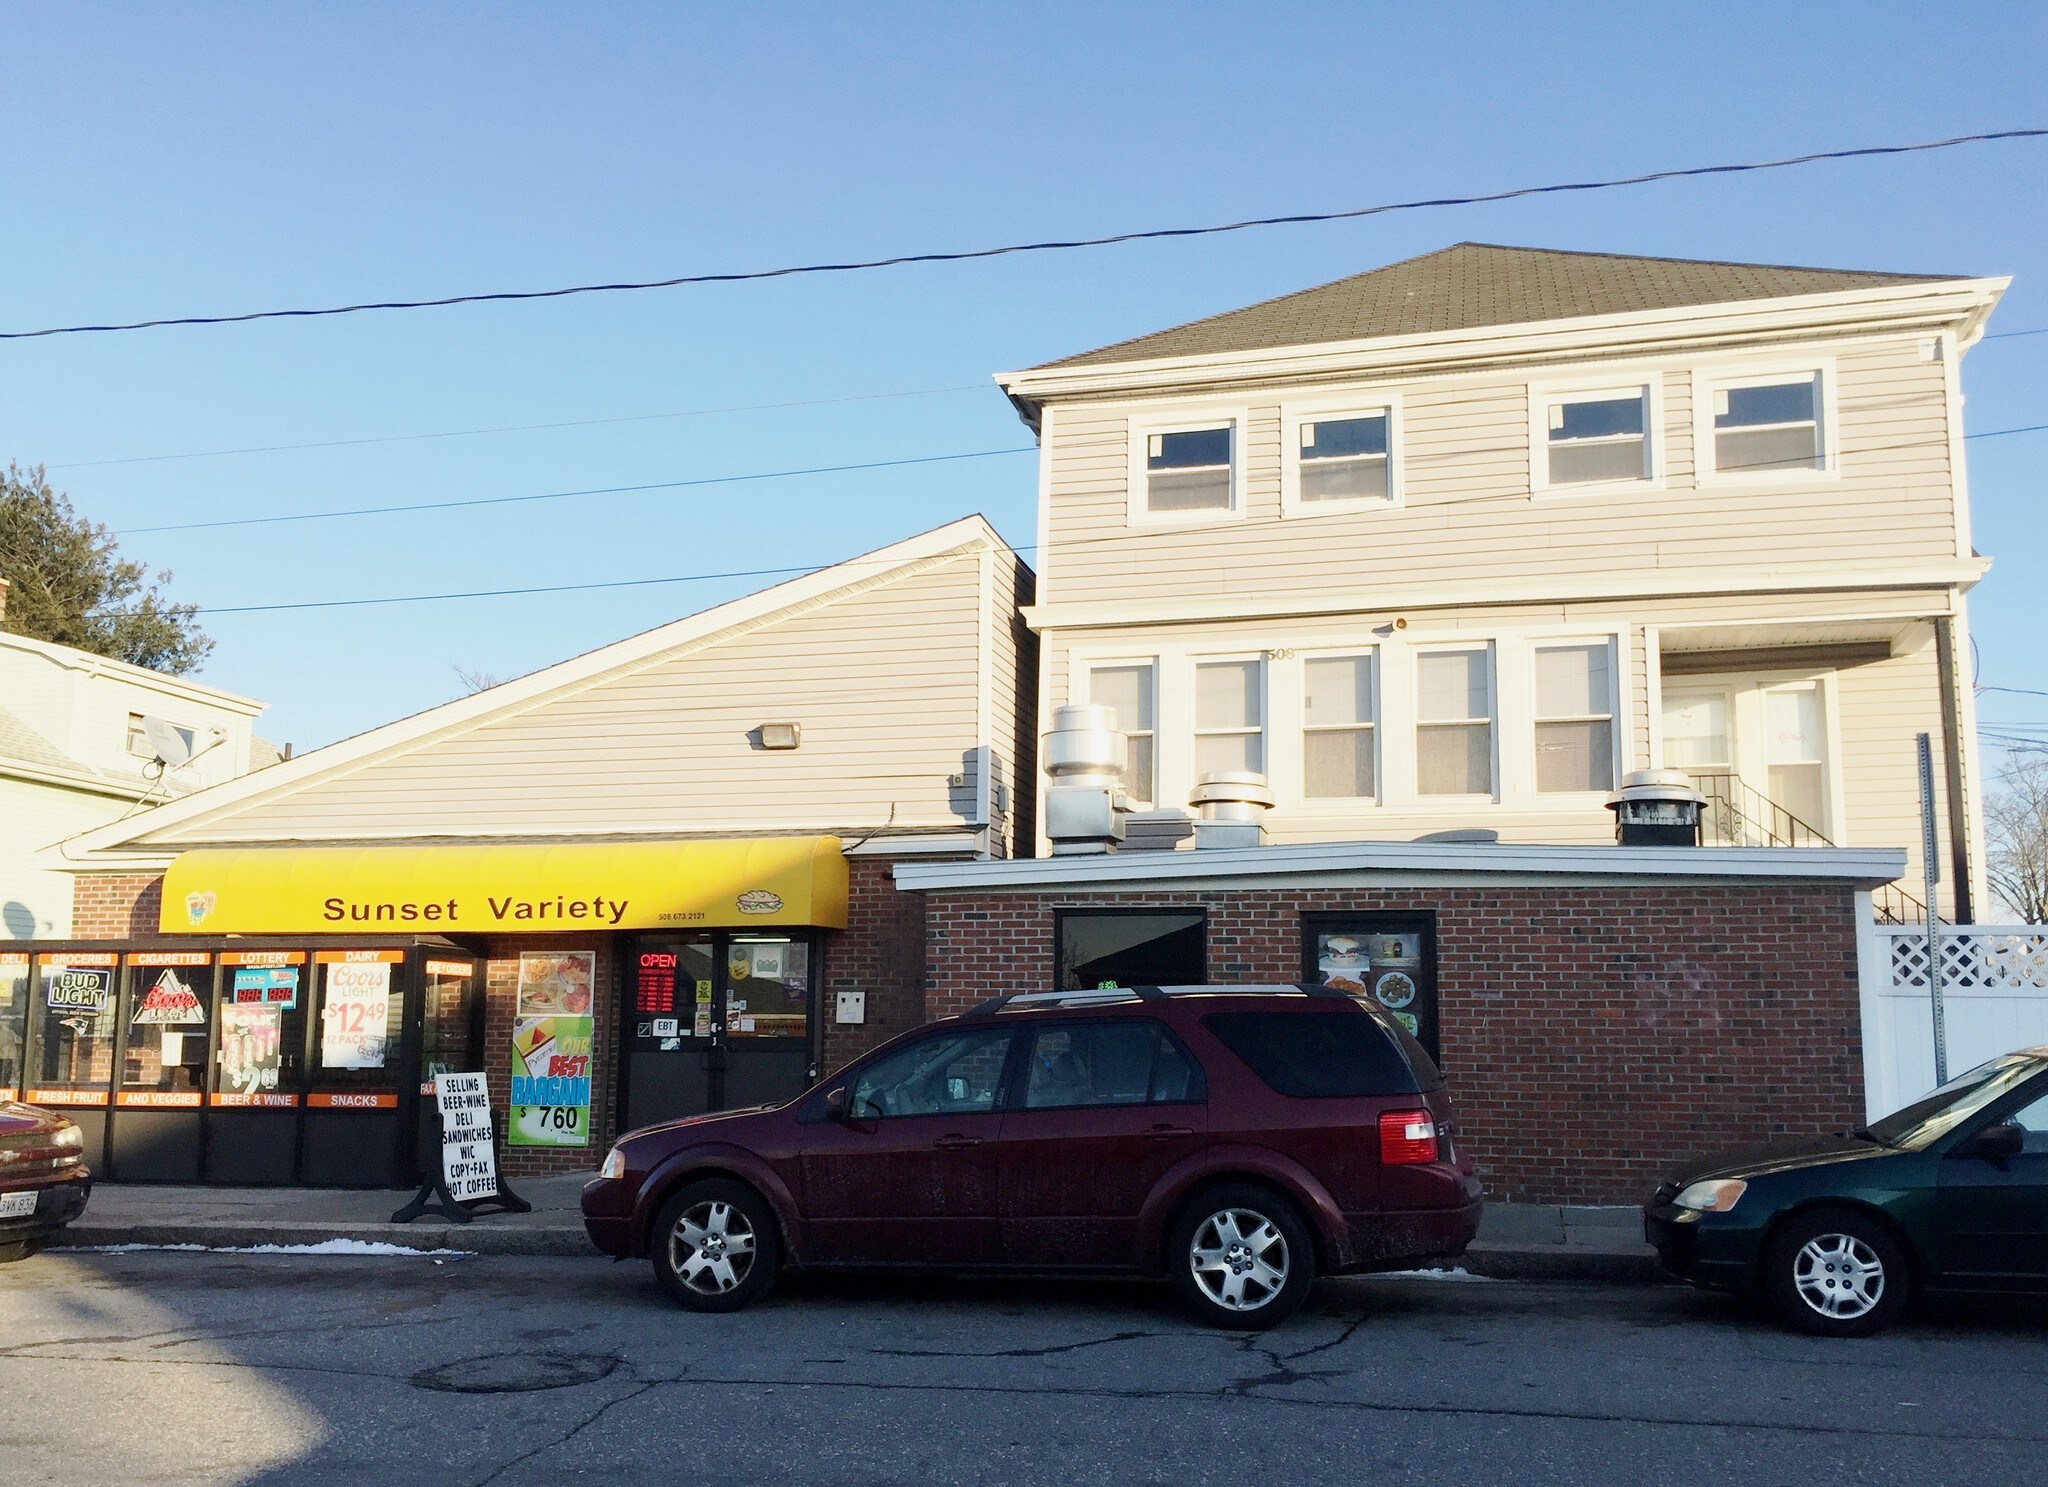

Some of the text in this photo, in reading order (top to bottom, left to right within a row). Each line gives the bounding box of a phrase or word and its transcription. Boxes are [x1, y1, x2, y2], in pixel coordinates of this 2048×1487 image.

[323, 896, 629, 924] Sunset Variety
[658, 913, 672, 921] 508
[688, 912, 705, 920] 2121
[1, 953, 25, 964] DELI
[51, 953, 112, 964] GROCERIES
[138, 953, 205, 964] CIGARETTES
[240, 952, 290, 963] LOTTERY
[345, 951, 381, 962] DAIRY
[640, 954, 677, 967] OPEN
[61, 973, 100, 990] BUD
[333, 965, 384, 987] Coors
[51, 987, 105, 1005] LIGHT
[143, 985, 199, 1010] Coors
[342, 987, 376, 997] LIGHT
[658, 1021, 673, 1031] EBT
[339, 1034, 366, 1045] PACK
[548, 1055, 589, 1078] BEST
[420, 1083, 434, 1094] FAX
[446, 1078, 479, 1093] SELLING
[511, 1076, 590, 1106] BARGAIN
[36, 1091, 104, 1103] FRESH FRUIT
[126, 1093, 199, 1105] AND VEGGIES
[220, 1094, 292, 1106] BEER & WINE
[331, 1094, 377, 1106] SNACKS
[443, 1094, 486, 1110] BEER-WINE
[520, 1106, 526, 1118] $
[455, 1112, 473, 1126] DELI
[443, 1127, 492, 1144] SANDWICHES
[460, 1145, 475, 1160] WIC
[450, 1161, 488, 1178] COPY-FAX
[466, 1177, 496, 1194] COFFEE
